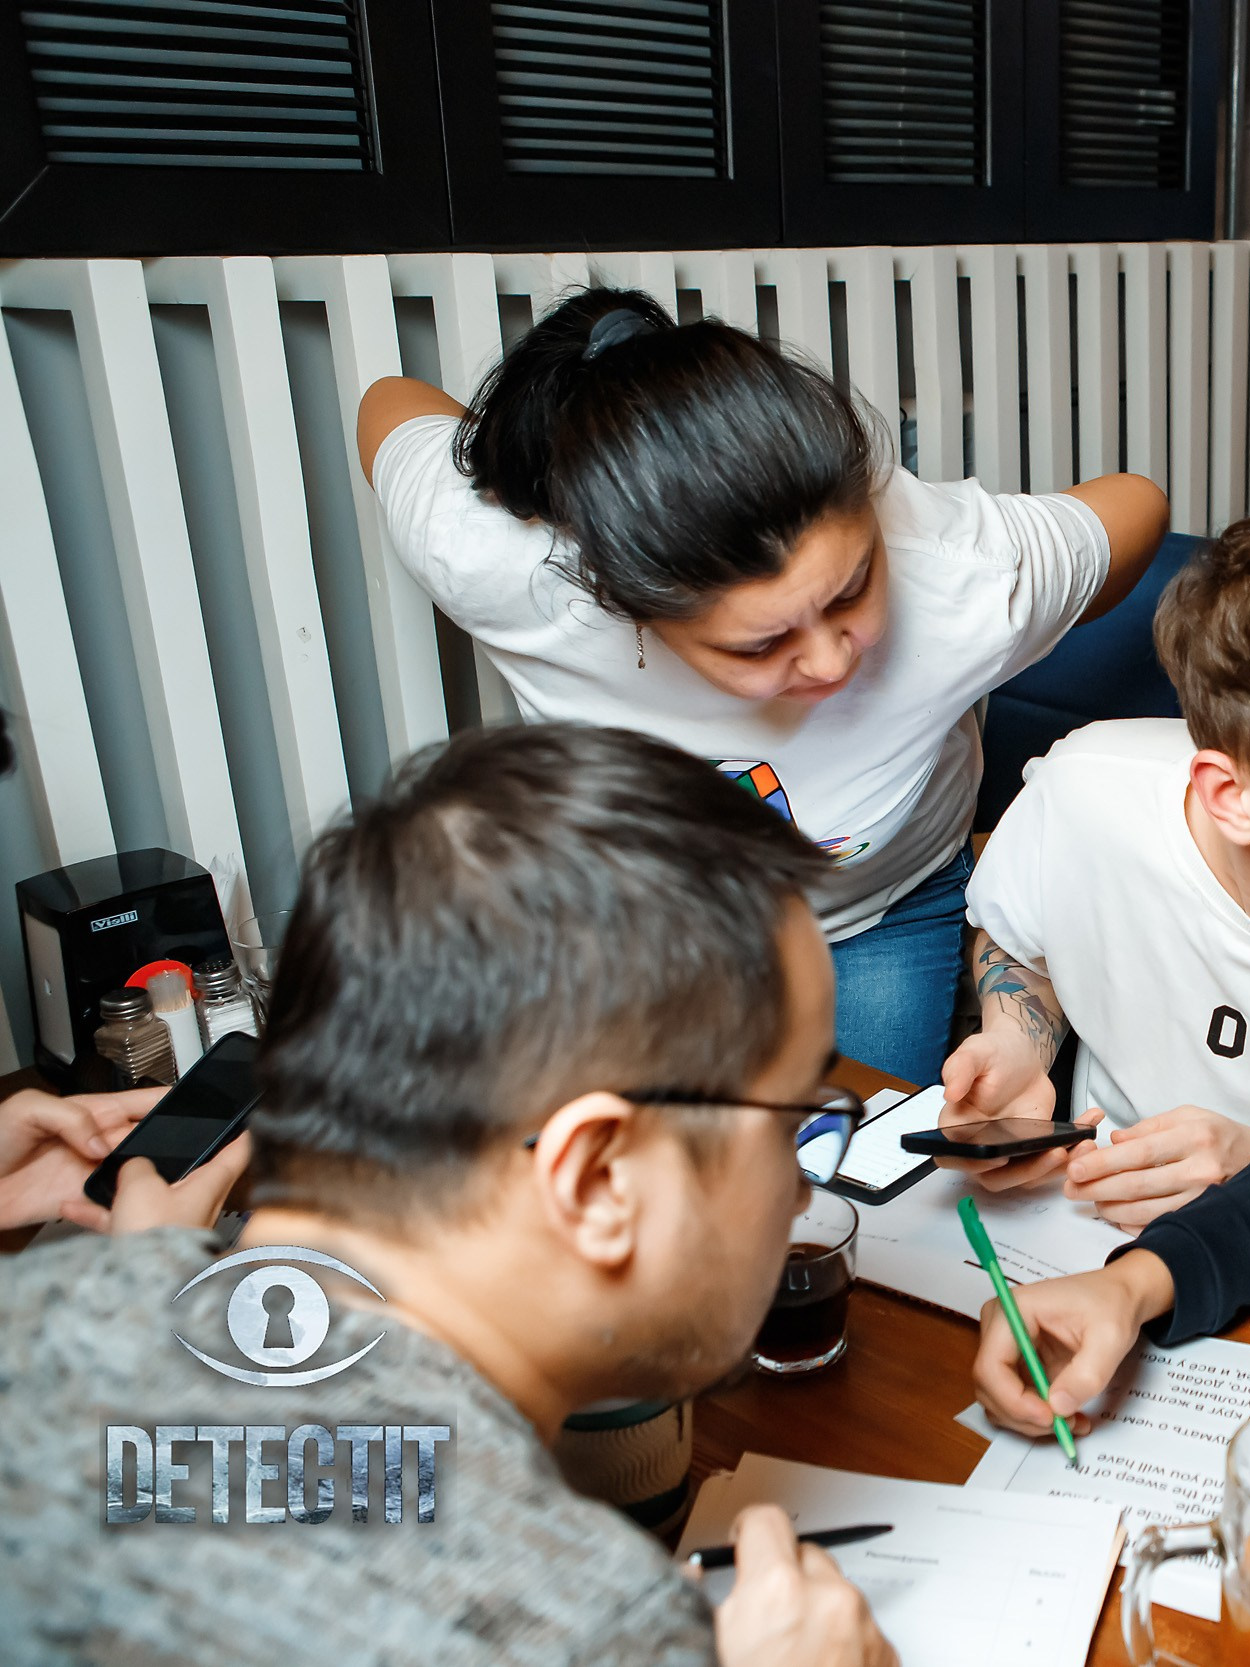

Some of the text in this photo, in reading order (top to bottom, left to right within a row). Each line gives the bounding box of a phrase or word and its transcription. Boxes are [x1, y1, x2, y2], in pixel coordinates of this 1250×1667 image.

[1167, 1371, 1225, 1388] добавь
[1128, 1389, 1190, 1408] желтом
[1211, 1407, 1243, 1421] круг
[1173, 1426, 1231, 1446] думать
[1092, 1467, 1112, 1479] of
[1097, 1453, 1226, 1490] nd you will have
[1116, 1472, 1168, 1492] sweep
[1172, 1486, 1198, 1501] the
[1202, 1493, 1224, 1506] dd
